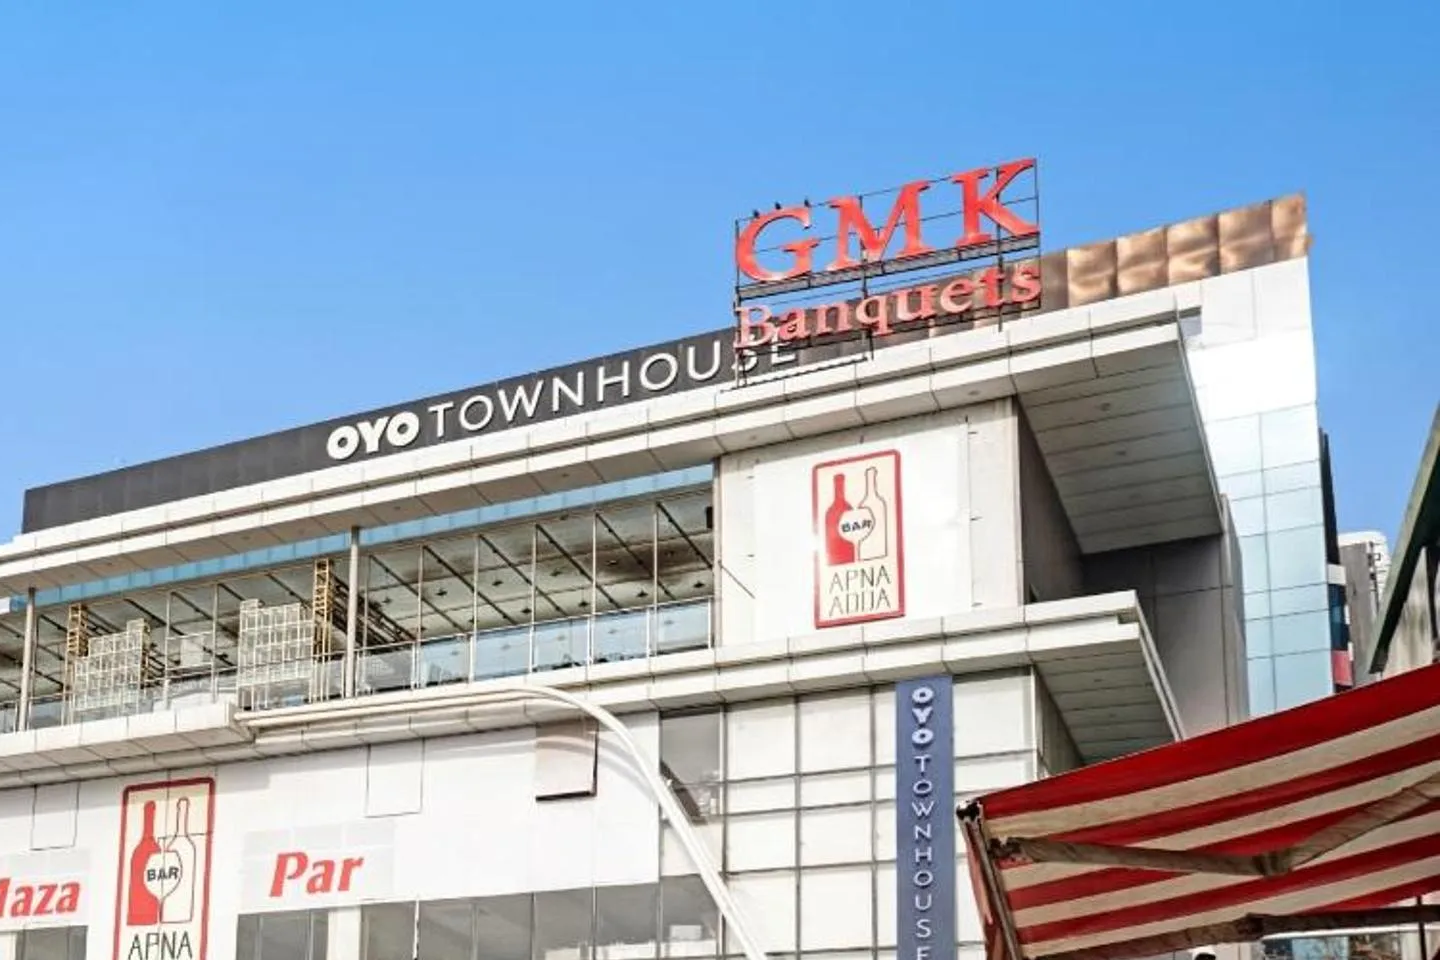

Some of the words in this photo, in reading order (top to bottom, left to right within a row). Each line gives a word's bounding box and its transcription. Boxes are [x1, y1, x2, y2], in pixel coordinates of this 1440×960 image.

[734, 157, 1040, 284] GMK
[732, 263, 1043, 350] Banquets
[326, 410, 420, 460] OYO
[841, 519, 872, 533] BAR
[829, 564, 892, 594] APNA
[911, 686, 935, 747] OYO
[146, 865, 179, 882] BAR
[268, 851, 365, 897] Par
